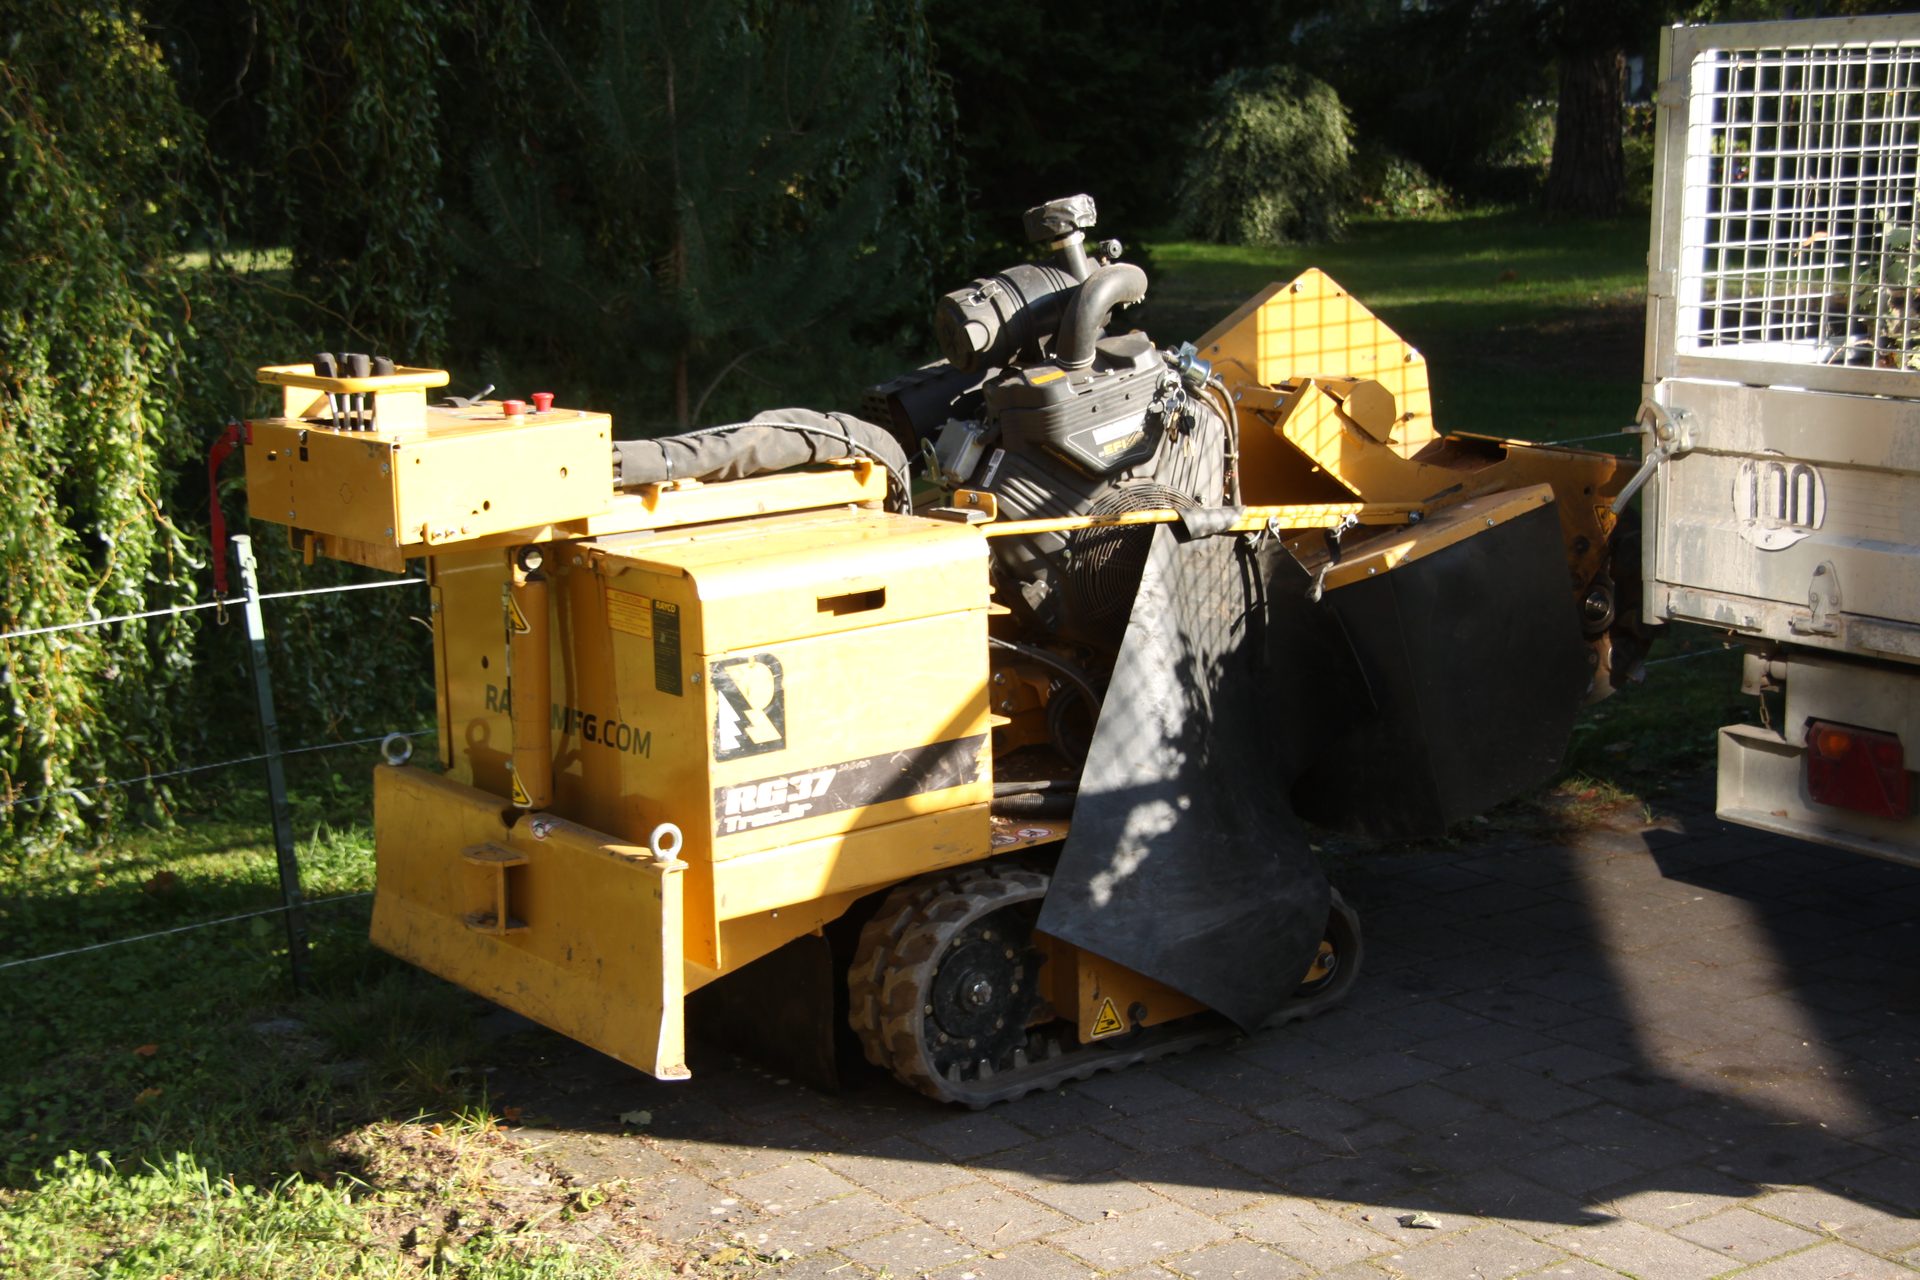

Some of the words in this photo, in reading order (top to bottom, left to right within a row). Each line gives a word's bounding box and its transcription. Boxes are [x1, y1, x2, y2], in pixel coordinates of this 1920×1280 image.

[1103, 438, 1127, 455] EFI
[485, 683, 652, 759] RAMFG.COM
[725, 768, 836, 816] RG37
